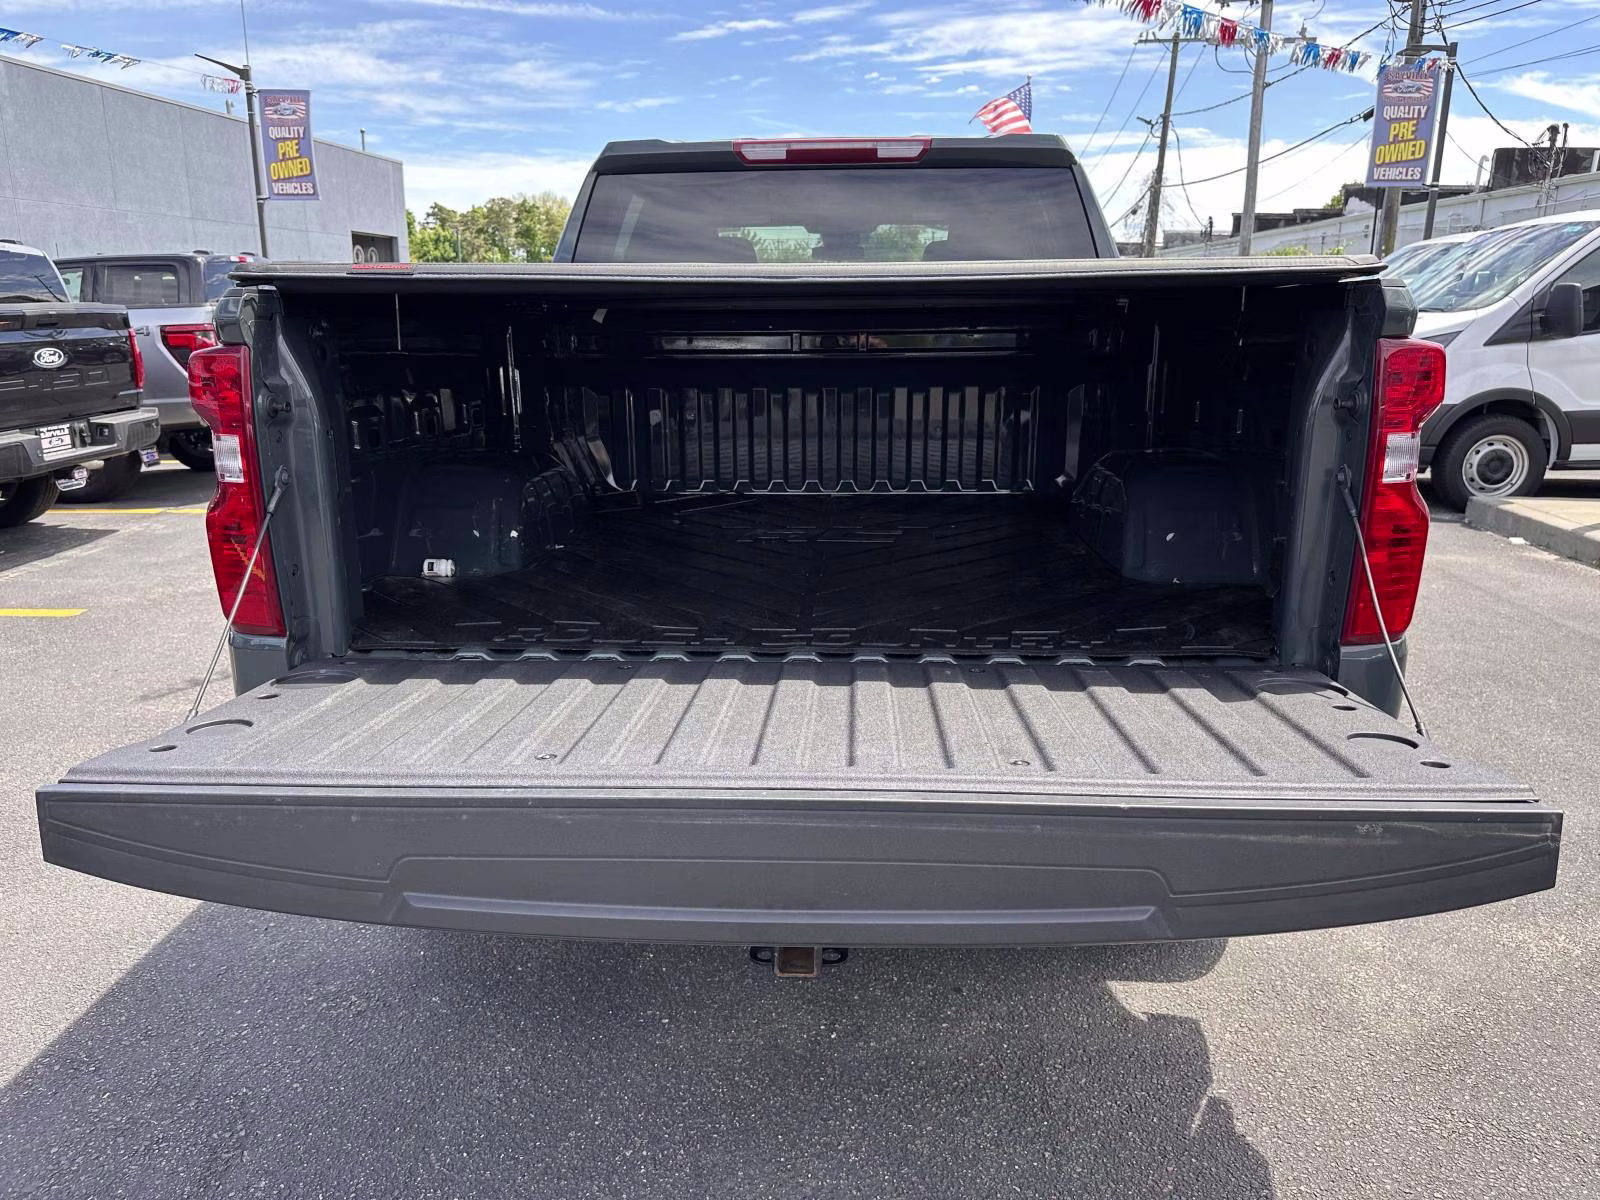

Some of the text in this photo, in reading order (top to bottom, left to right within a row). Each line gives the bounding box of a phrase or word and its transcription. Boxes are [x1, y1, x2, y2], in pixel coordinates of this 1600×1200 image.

[1383, 105, 1428, 120] QUALITY
[268, 126, 305, 139] QUALITY
[1389, 120, 1417, 142] PRE
[278, 140, 300, 160] PRE
[1375, 140, 1426, 165] OWNED
[270, 158, 311, 180] OWNED
[1373, 167, 1422, 180] VEHICLES
[272, 182, 314, 194] VEHICLES
